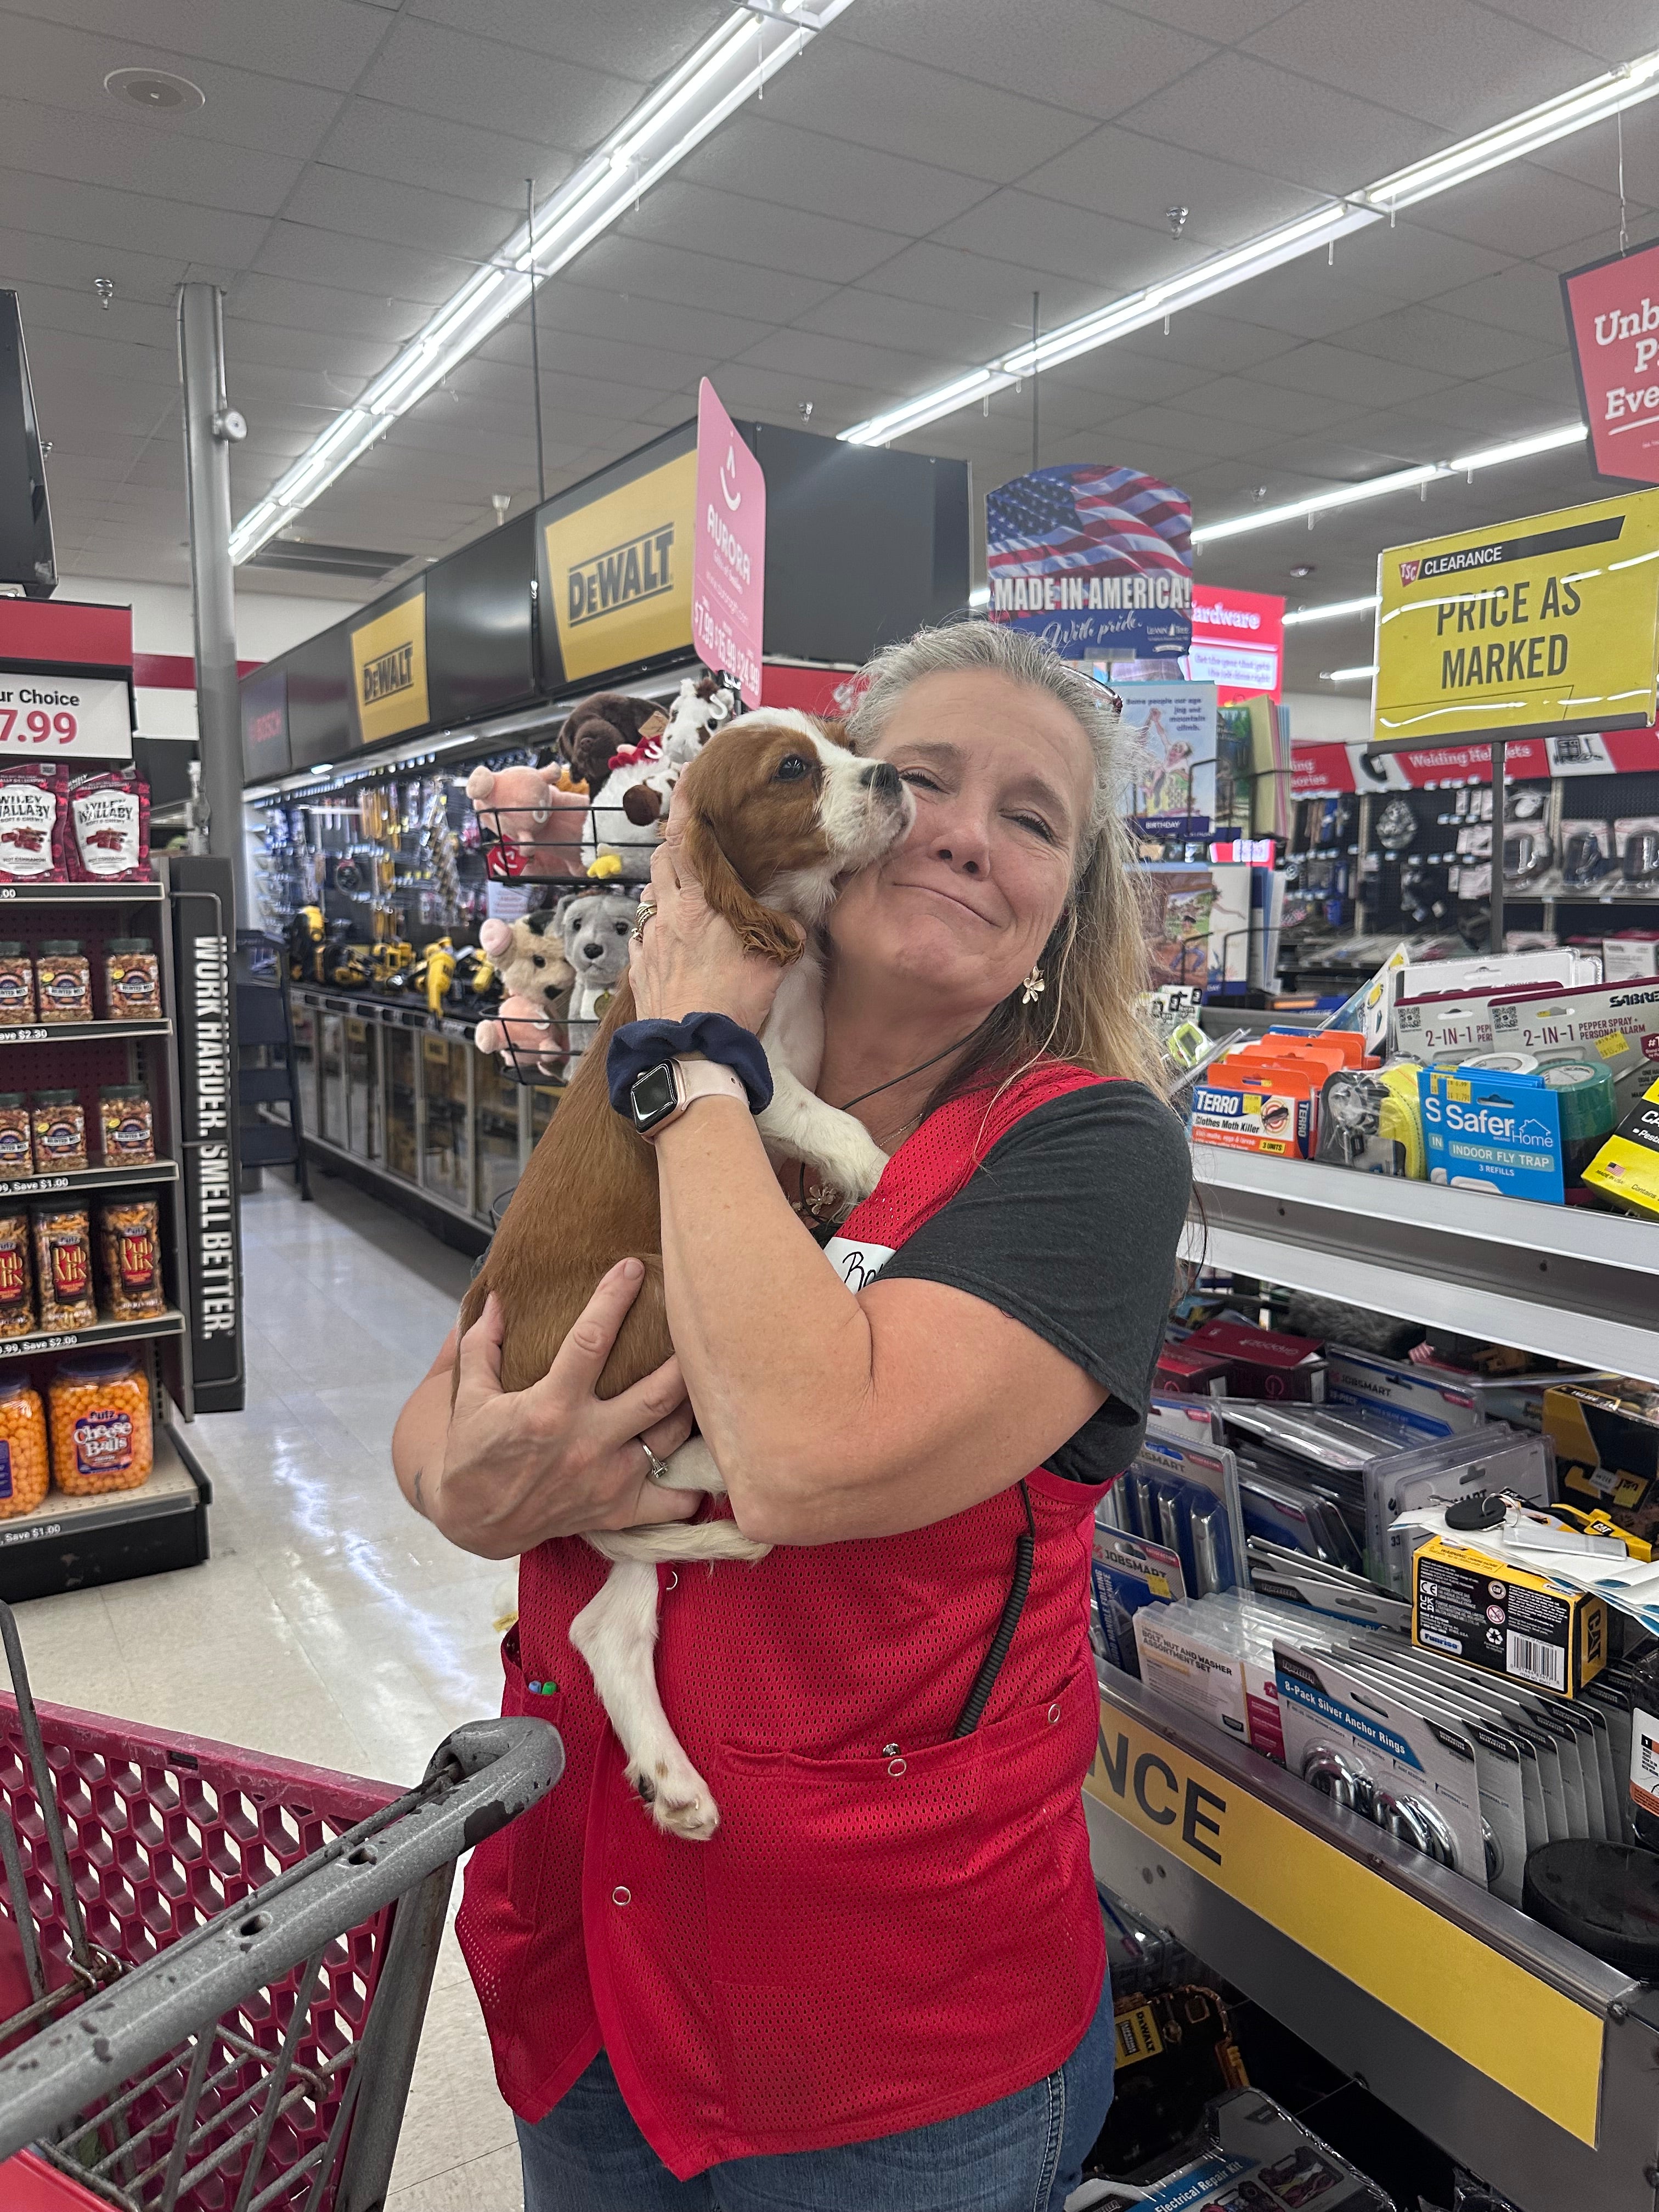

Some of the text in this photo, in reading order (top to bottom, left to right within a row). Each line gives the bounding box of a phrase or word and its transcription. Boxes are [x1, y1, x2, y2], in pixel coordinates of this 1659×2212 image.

[1634, 338, 1659, 374] P
[707, 504, 751, 586] AURORA
[1424, 546, 1503, 575] CLEARANCE
[994, 577, 1191, 611] MADE IN AMERICA!
[1437, 572, 1581, 636] PRICE AS
[1192, 600, 1261, 630] ardware
[1441, 634, 1568, 690] MARKED
[19, 689, 81, 707] Choice
[1408, 744, 1533, 768] Welding Helets
[0, 804, 50, 818] ALLABY
[1145, 821, 1180, 830] BIRTHDAY
[1609, 990, 1659, 1008] SABRE
[194, 935, 231, 1137] WORK HARDER.
[1425, 1025, 1472, 1047] 2-IN-1
[1476, 1024, 1492, 1034] PEP
[1523, 1024, 1575, 1047] 2-IN-1
[1578, 1016, 1633, 1032] PEPPER SPRAY
[1620, 1024, 1646, 1035] ALARM
[1197, 1090, 1239, 1115] TERRO
[1195, 1115, 1260, 1134] Clothes Moth Killer
[1298, 1101, 1310, 1138] TERRO
[1446, 1104, 1515, 1137] Safer
[1267, 1143, 1283, 1152] UNITS
[1511, 1130, 1554, 1148] Home
[1452, 1144, 1549, 1168] INDOOR FLY TRAP
[1479, 1164, 1515, 1177] 3 REFILLS
[199, 1143, 236, 1340] SMELL BETTER.
[74, 1421, 133, 1444] Cheese
[86, 1437, 128, 1458] Balls
[1141, 1451, 1186, 1474] SMART
[1593, 1522, 1611, 1533] CAT
[1104, 1549, 1167, 1578] JOBSMART
[1424, 1633, 1458, 1649] Funrise
[1587, 1609, 1602, 1664] CAT
[1142, 1629, 1162, 1645] BOLT,
[1163, 1639, 1180, 1652] NUT
[1180, 1647, 1198, 1660] AND
[1198, 1654, 1233, 1676] WASHER
[1143, 1638, 1211, 1673] ASSORTMENT SET
[1282, 1659, 1316, 1684] TRAVELLER
[1284, 1680, 1406, 1754] 8-Pack Silver Anchor Rings
[1154, 2160, 1244, 2212] Electrical Repair Kit
